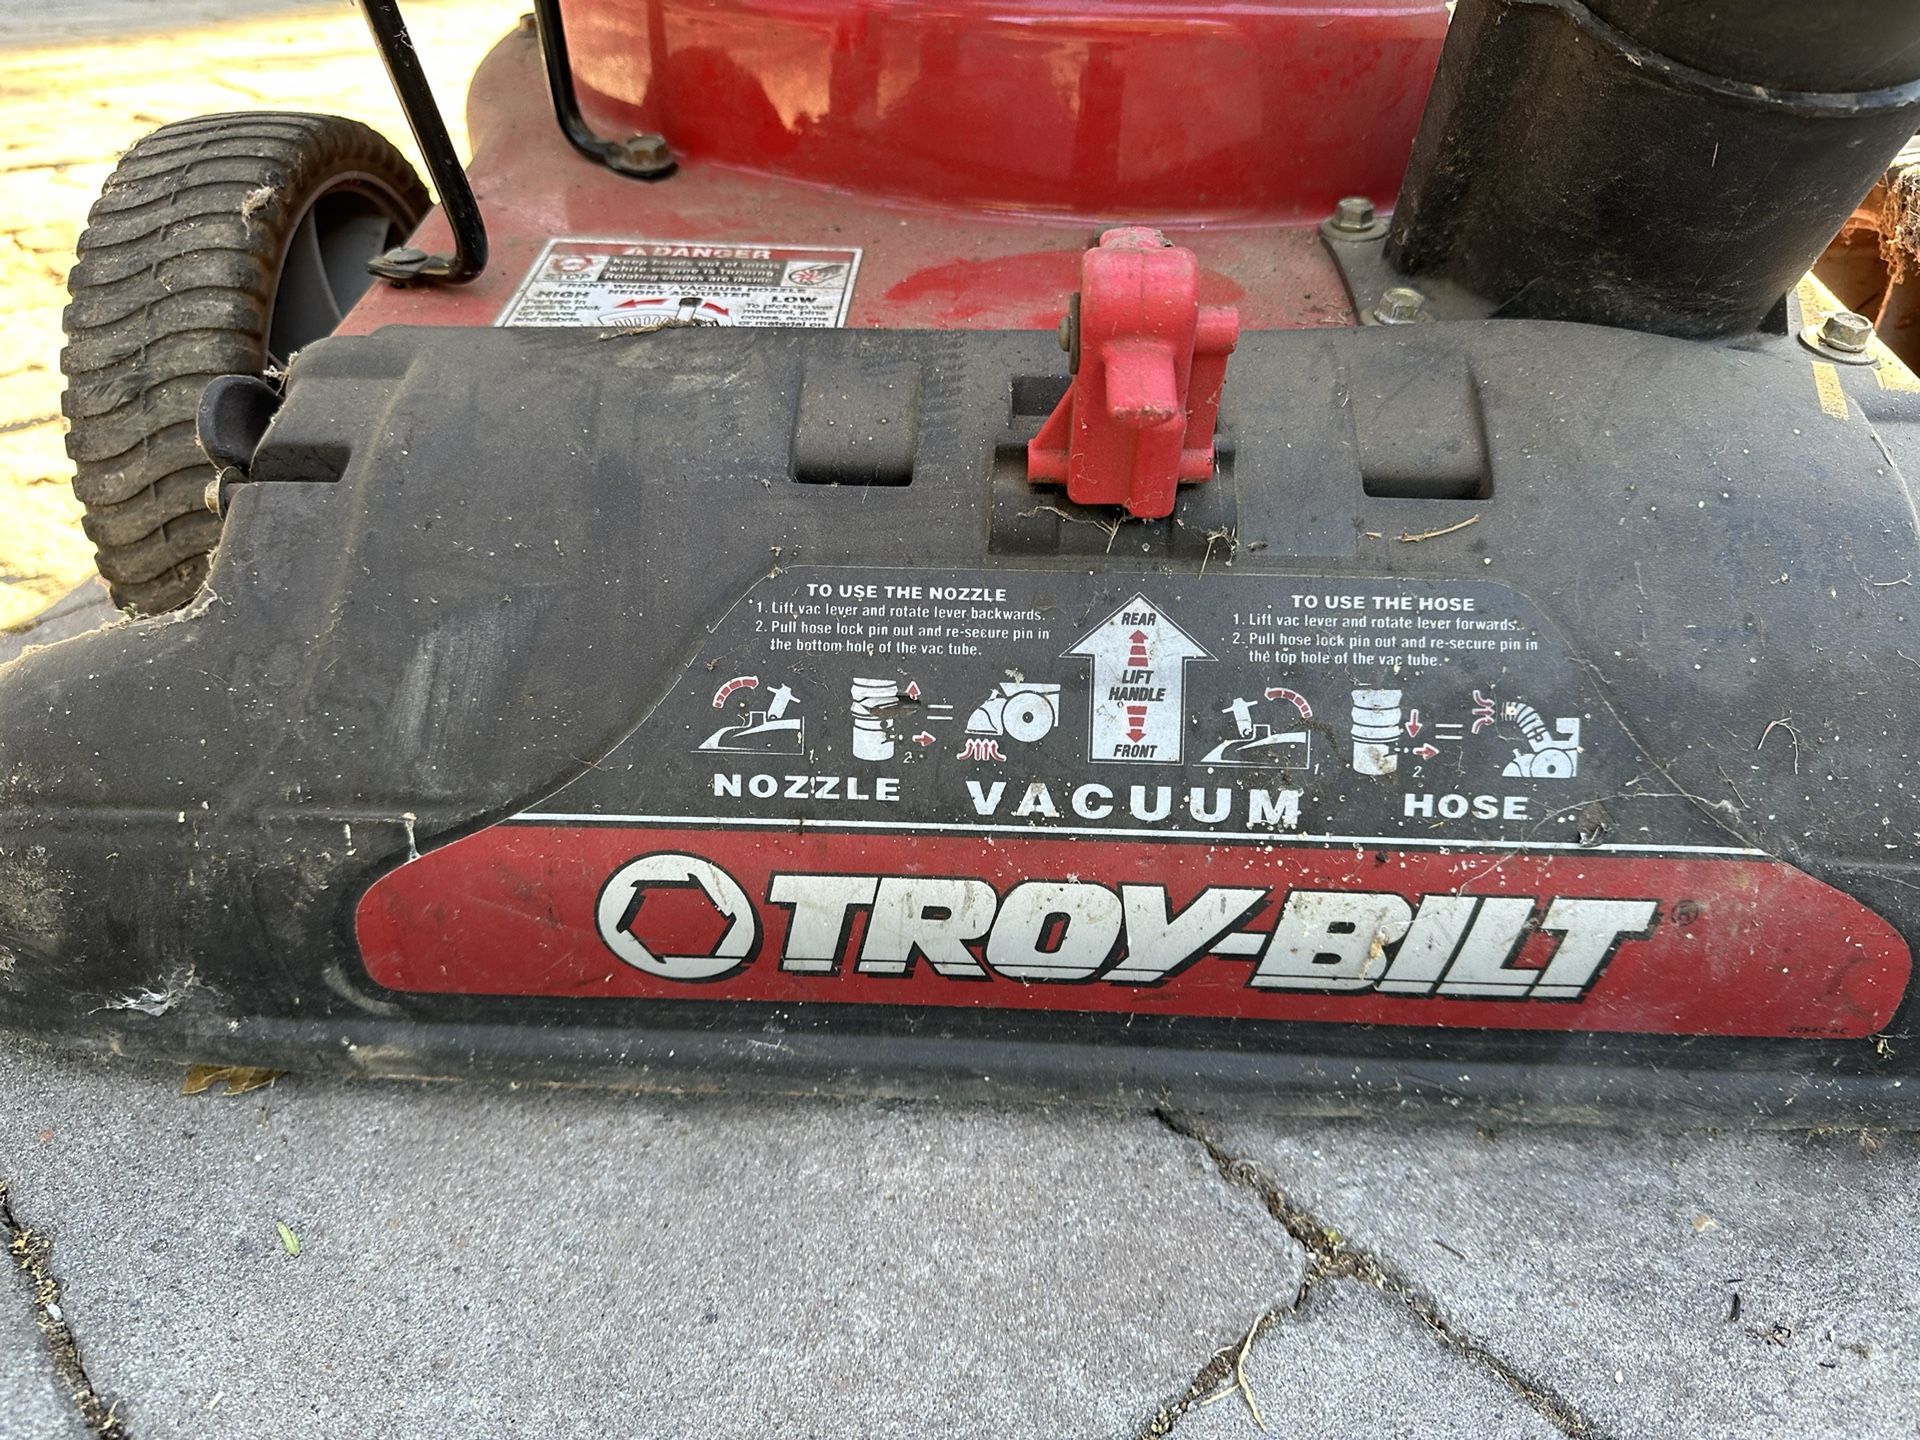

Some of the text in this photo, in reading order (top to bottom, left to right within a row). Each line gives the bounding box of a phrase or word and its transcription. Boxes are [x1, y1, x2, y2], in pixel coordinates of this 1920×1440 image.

[653, 246, 772, 259] DANGER
[612, 258, 647, 266] Keep
[652, 259, 693, 267] hands
[604, 273, 659, 281] Rotating
[662, 274, 704, 282] blades
[651, 267, 699, 275] engine
[721, 269, 775, 277] running
[536, 290, 591, 299] HIGH
[806, 583, 1007, 602] TO USE THE NOZZLE
[756, 601, 1046, 621] 1. Lift vac lever and rotate lever backwards.
[1291, 595, 1475, 611] TO USE THE HOSE
[1121, 612, 1157, 626] REAR
[1233, 613, 1521, 631] 1. Lift vac lever and rotate lever forwards.
[755, 620, 1050, 642] 2. Pull hose lock pin out and re-secure pin in
[770, 638, 982, 656] the bottom hole of the vac tube.
[1232, 632, 1538, 653] 2. Pull hose lock pin out and re-secure pin in
[1249, 650, 1442, 667] the top hole of the vac tube.
[1121, 670, 1154, 684] LIFT
[1108, 687, 1166, 702] HANDLE
[809, 749, 915, 764] 1. 2.
[1113, 744, 1158, 758] FRONT
[1314, 763, 1425, 778] 1. 2.
[713, 773, 900, 801] NOZZLE
[966, 780, 1299, 825] VACUUM
[1404, 793, 1528, 821] HOSE
[768, 874, 1659, 999] TROY-BILT
